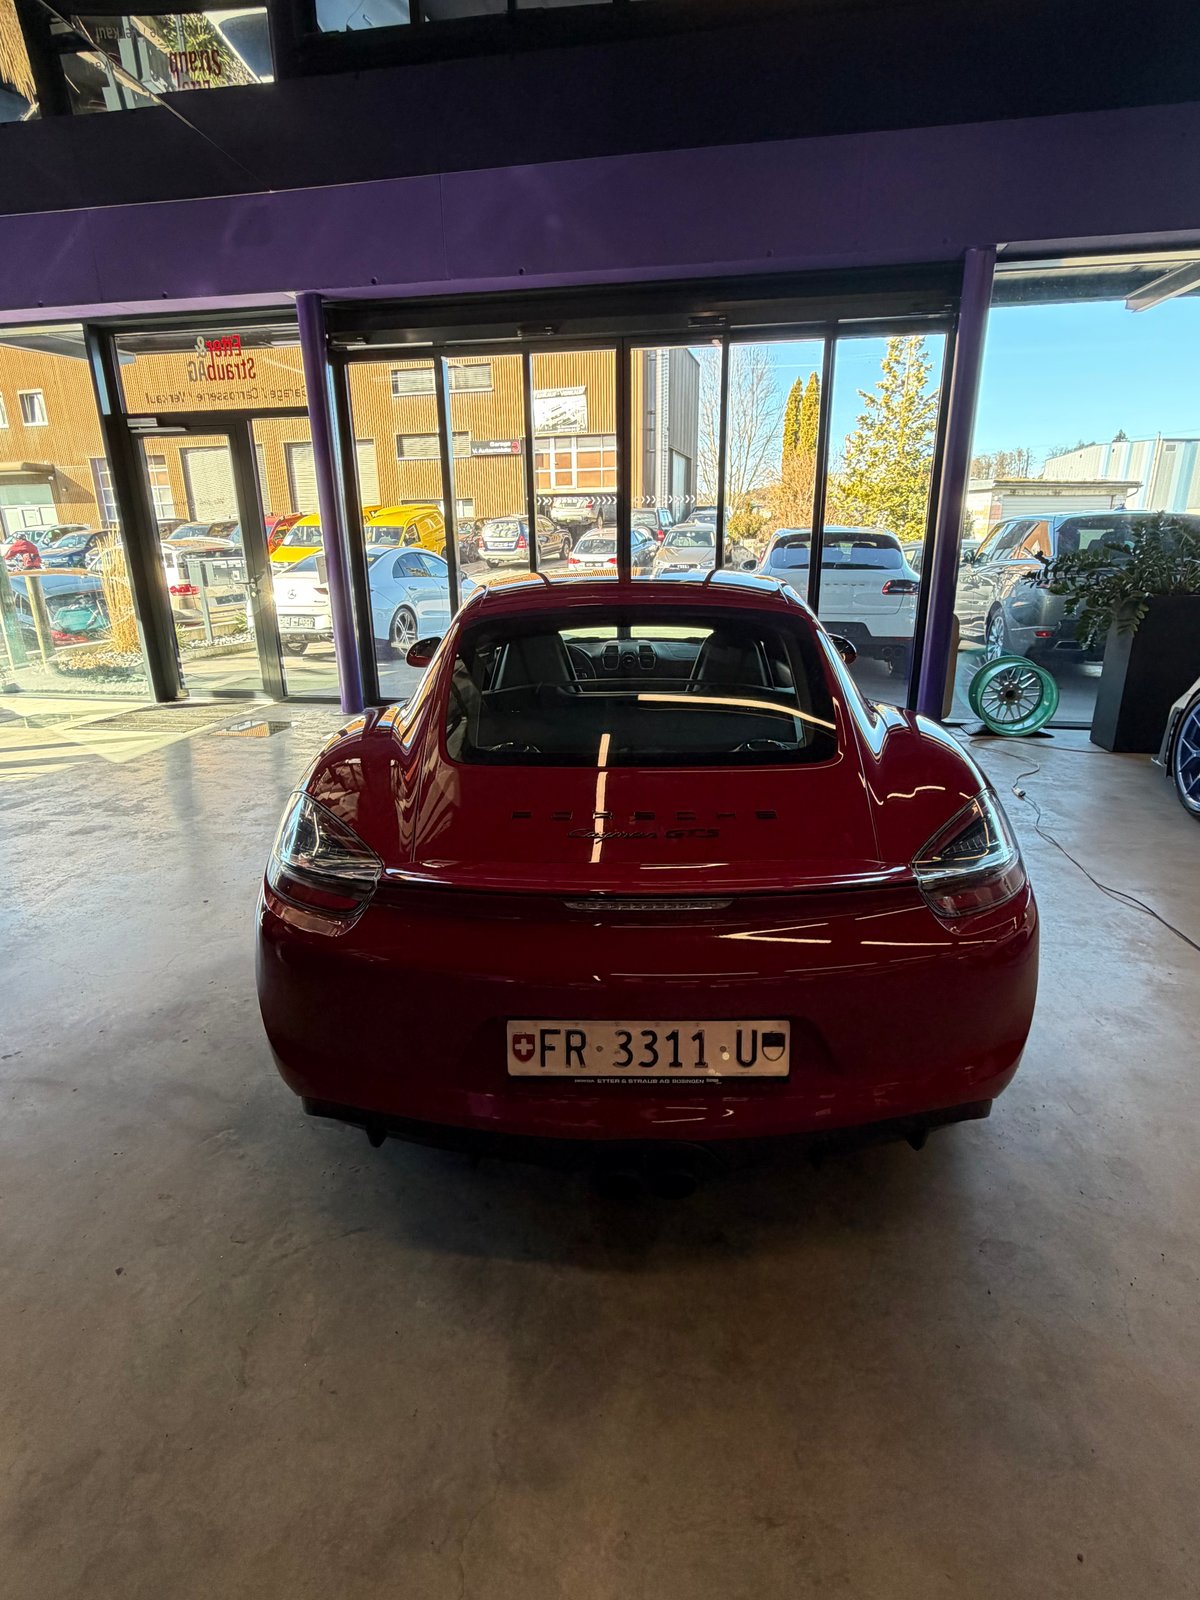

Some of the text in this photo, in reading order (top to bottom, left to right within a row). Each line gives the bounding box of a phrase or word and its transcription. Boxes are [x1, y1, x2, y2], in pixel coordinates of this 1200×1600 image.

[168, 49, 222, 78] Straub
[567, 827, 721, 845] Cayman GTS
[540, 1028, 759, 1069] FR 3311 U
